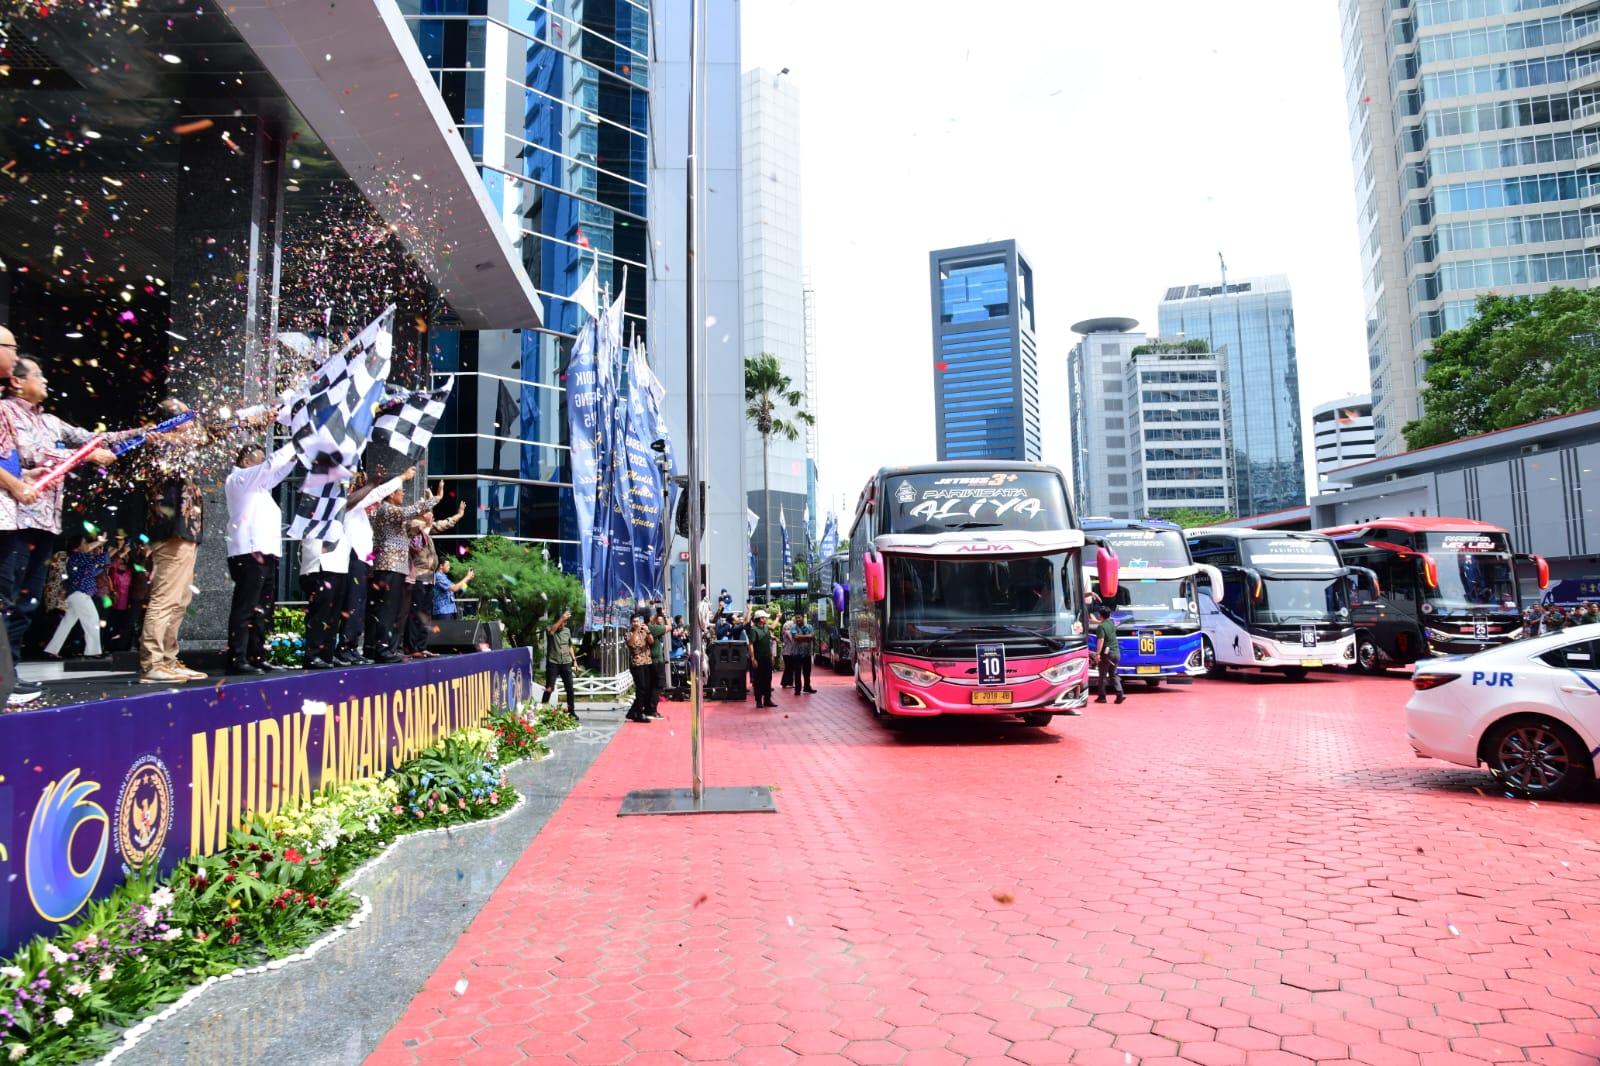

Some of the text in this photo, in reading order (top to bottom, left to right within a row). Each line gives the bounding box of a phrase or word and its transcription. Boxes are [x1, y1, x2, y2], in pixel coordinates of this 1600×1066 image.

[922, 488, 1028, 499] PARIWISATA
[1476, 624, 1486, 634] 25
[1140, 638, 1154, 652] 06
[982, 658, 1000, 676] 10
[1472, 671, 1514, 687] PJR
[191, 671, 491, 858] MUDIK AMAN SAMPAI TUJUAN
